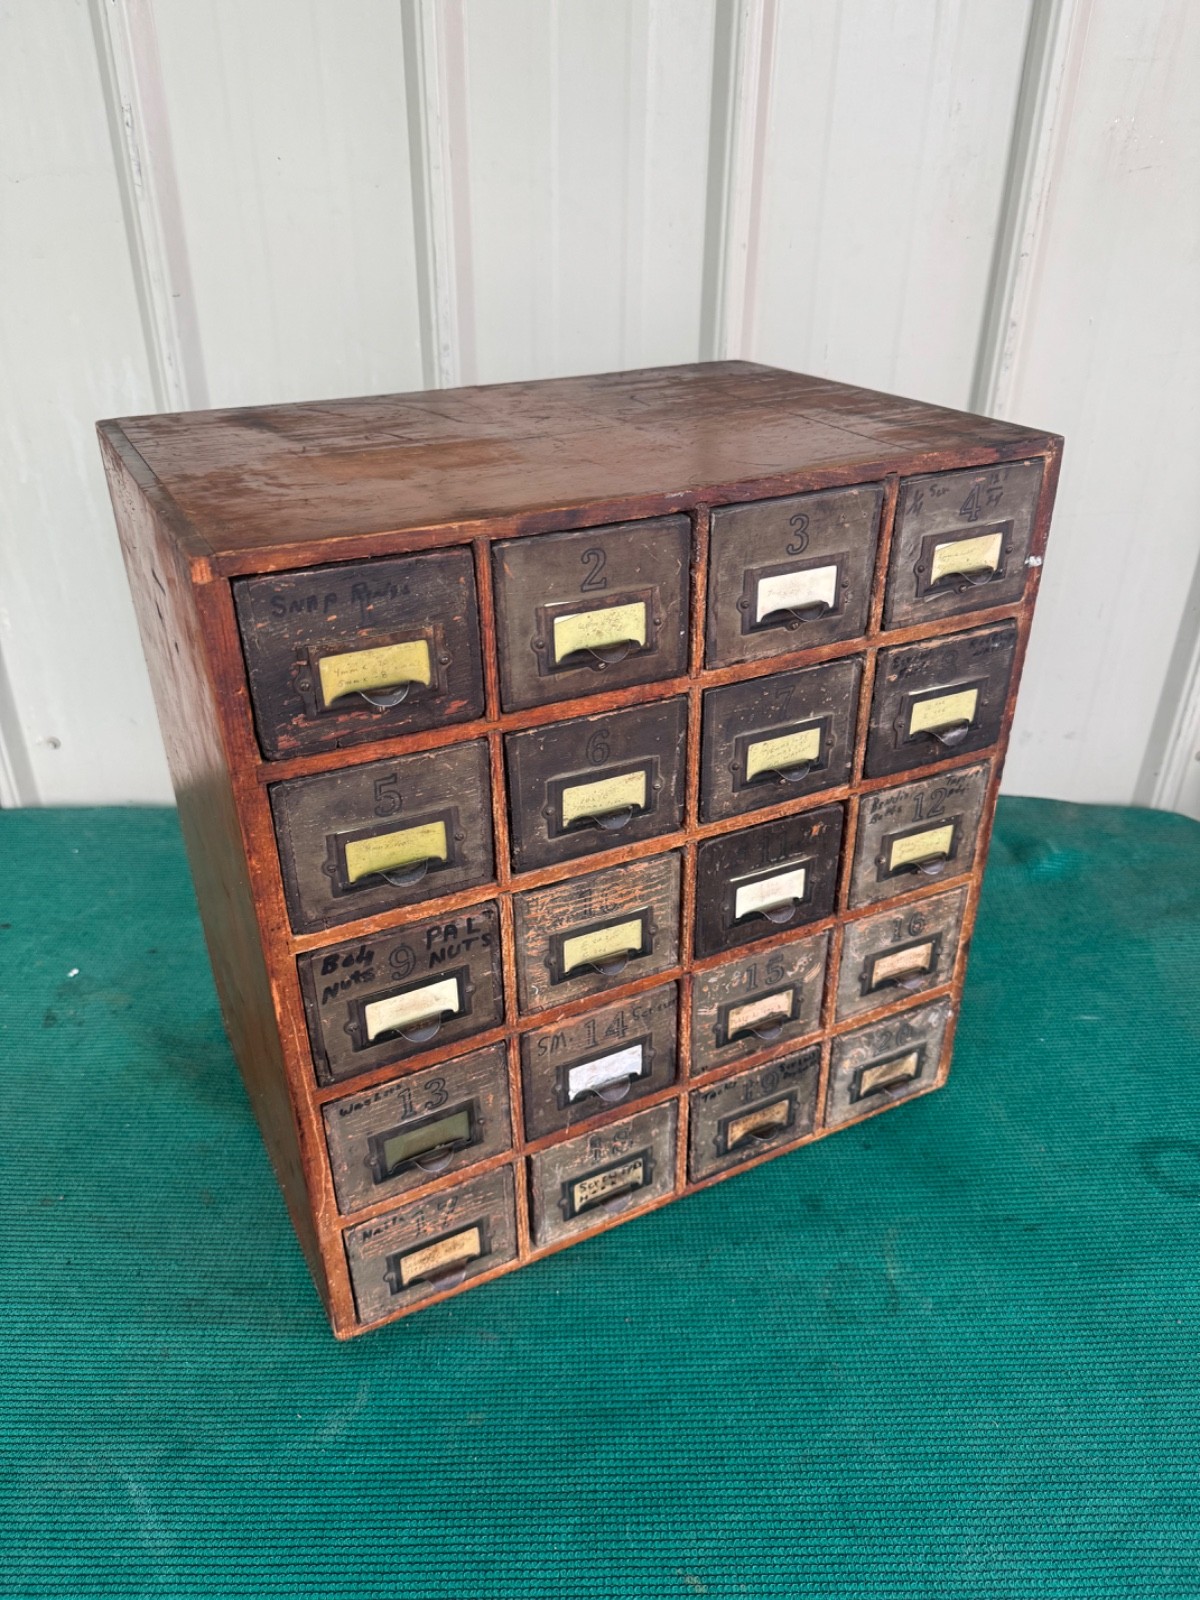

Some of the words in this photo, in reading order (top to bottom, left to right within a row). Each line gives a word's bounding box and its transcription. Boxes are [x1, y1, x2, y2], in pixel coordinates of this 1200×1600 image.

[959, 484, 981, 522] 4
[786, 513, 810, 555] 3
[581, 548, 607, 593] 2
[776, 684, 796, 719] 7
[586, 729, 611, 767] 6
[374, 772, 403, 818] 5
[911, 786, 949, 823] 12
[890, 911, 926, 943] 16
[388, 943, 417, 981] 9
[428, 932, 493, 969] NUTS
[745, 953, 786, 993] 15
[584, 1010, 629, 1049] 14
[398, 1077, 449, 1120] 13
